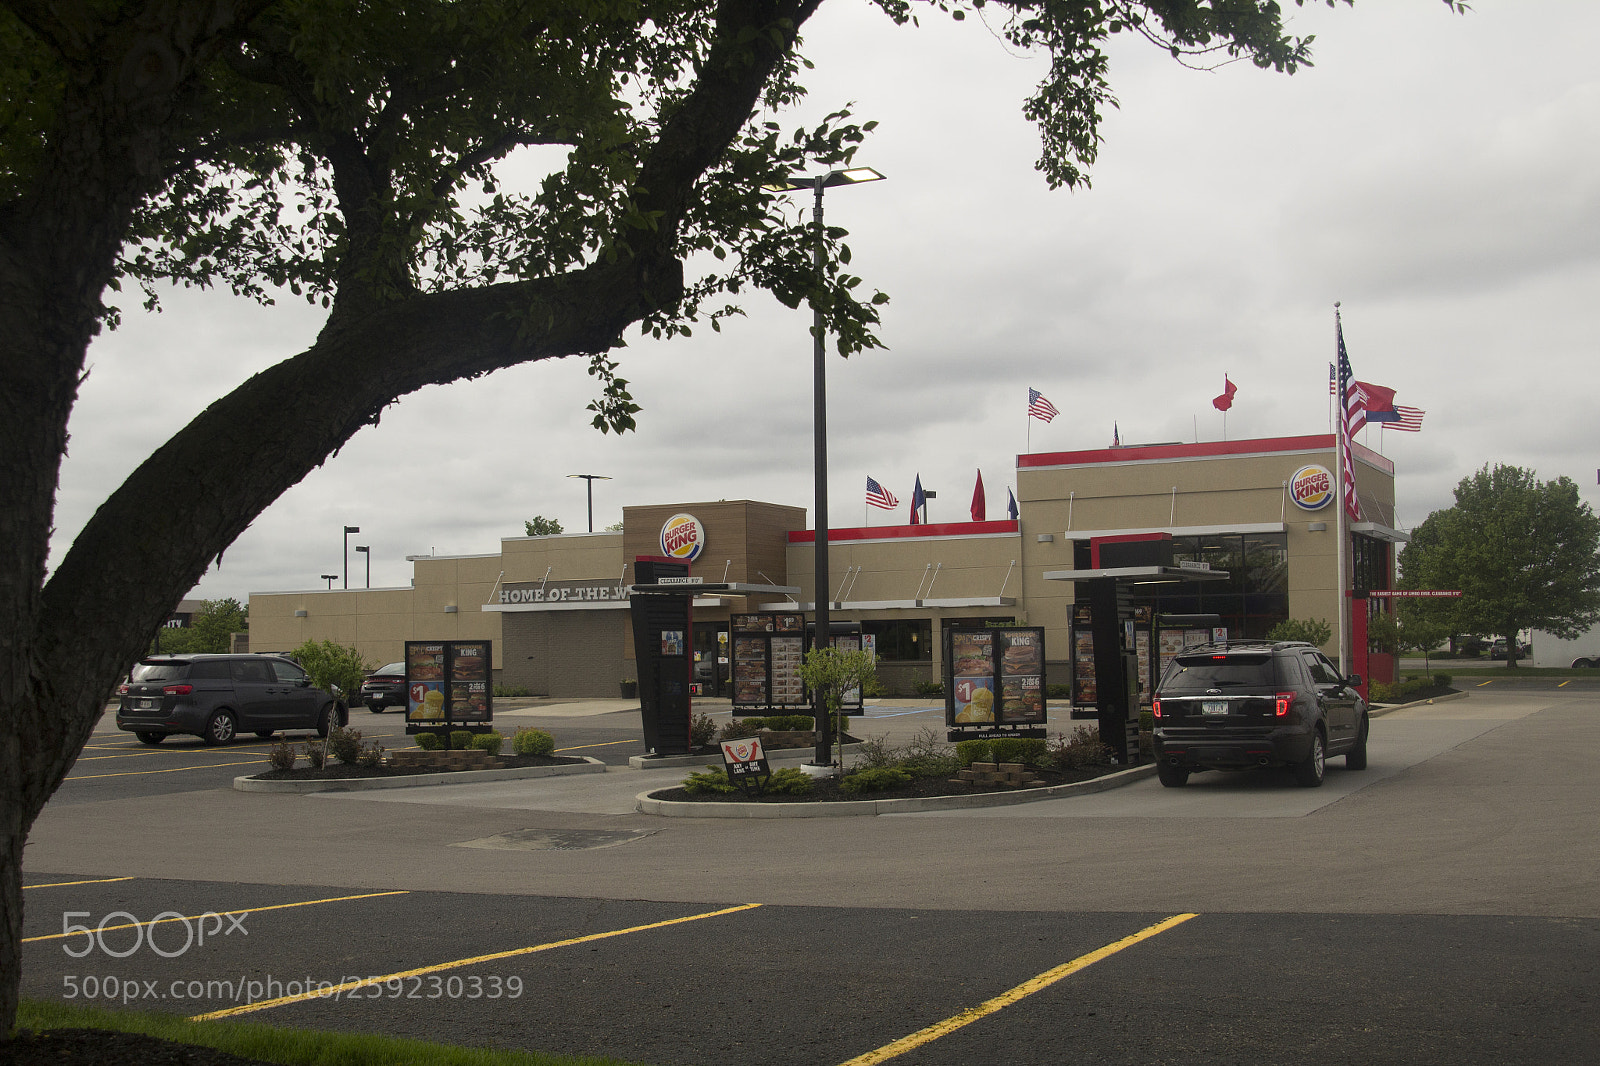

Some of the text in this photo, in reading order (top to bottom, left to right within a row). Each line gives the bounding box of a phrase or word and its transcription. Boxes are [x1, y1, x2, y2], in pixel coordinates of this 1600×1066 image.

[1294, 472, 1328, 490] BURGER
[1296, 480, 1329, 501] KING
[665, 522, 696, 542] BURGER
[666, 530, 697, 554] KING
[498, 589, 545, 603] HOME
[549, 588, 571, 601] OF
[575, 586, 610, 600] THE
[1011, 637, 1030, 646] KING
[460, 648, 477, 657] KING
[413, 685, 424, 701] $1
[958, 682, 971, 701] $1
